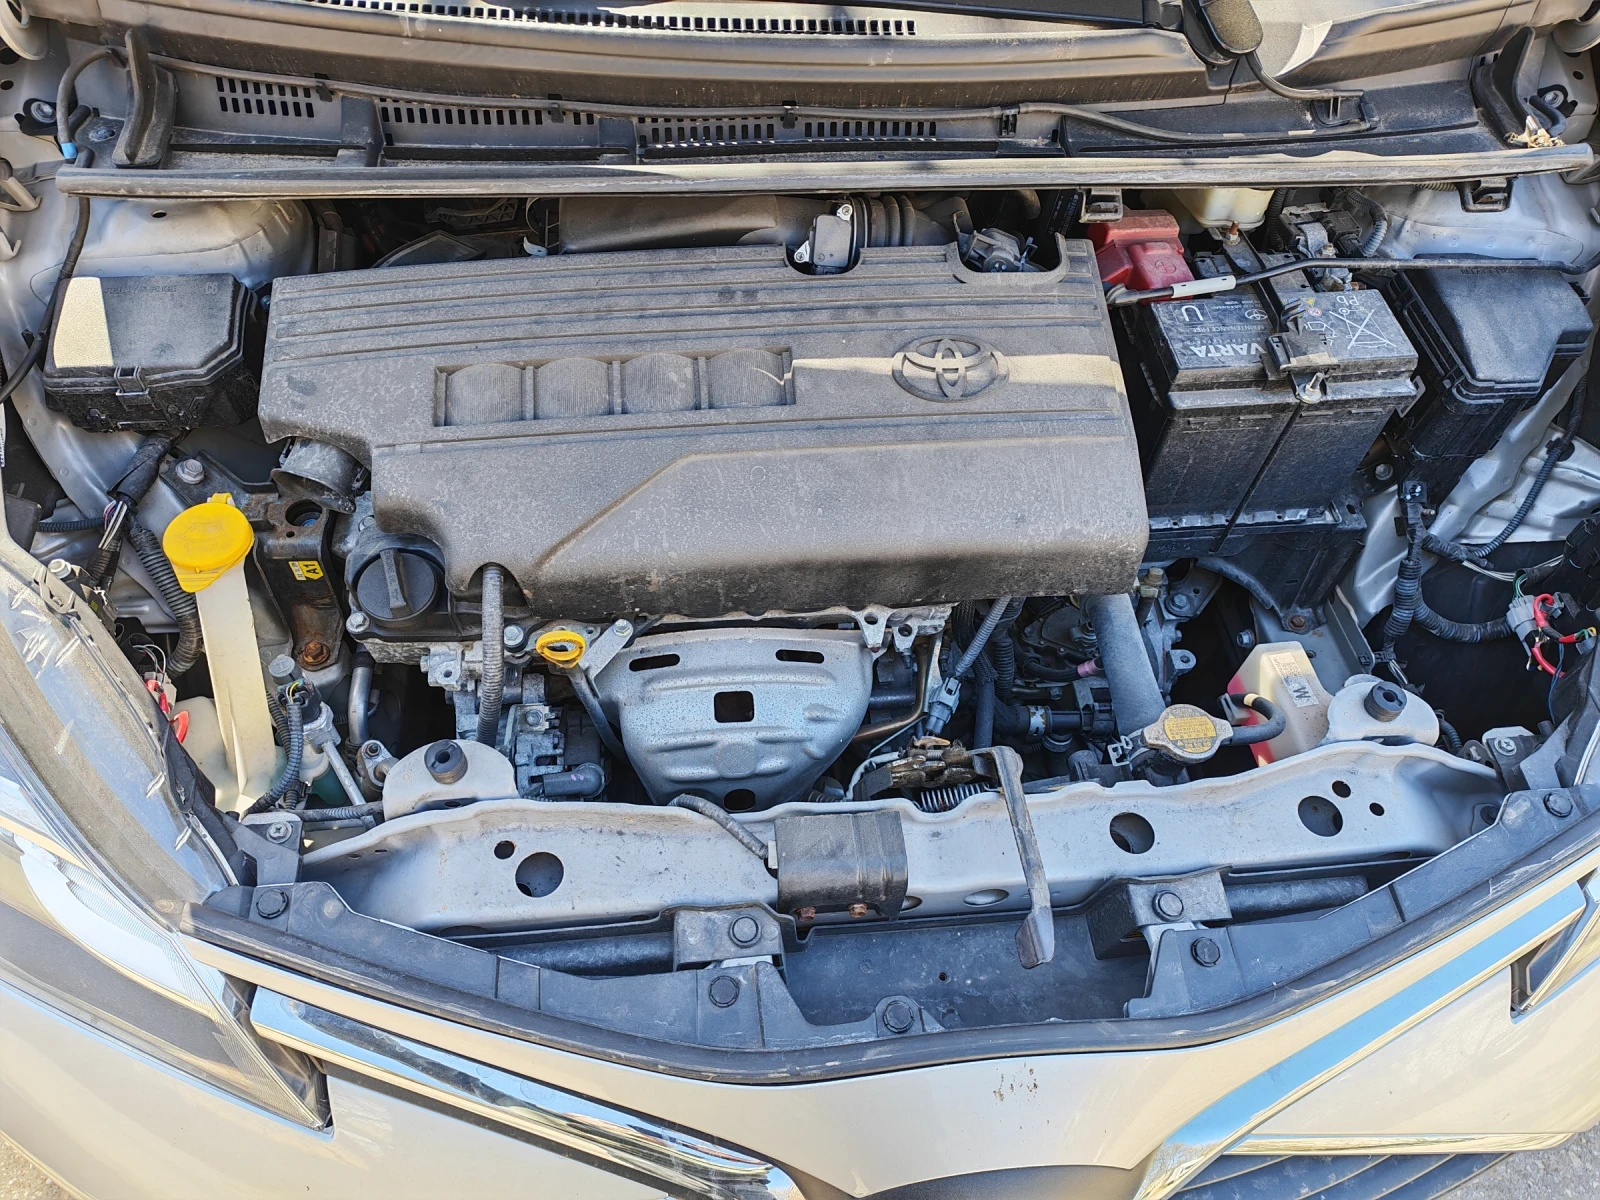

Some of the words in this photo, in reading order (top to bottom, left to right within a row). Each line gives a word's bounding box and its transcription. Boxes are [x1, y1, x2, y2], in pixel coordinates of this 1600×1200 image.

[1336, 295, 1360, 306] Pb
[1181, 305, 1204, 322] U
[1211, 324, 1265, 332] MAINTENANCE
[1189, 342, 1267, 358] VARTA
[304, 563, 320, 575] A1
